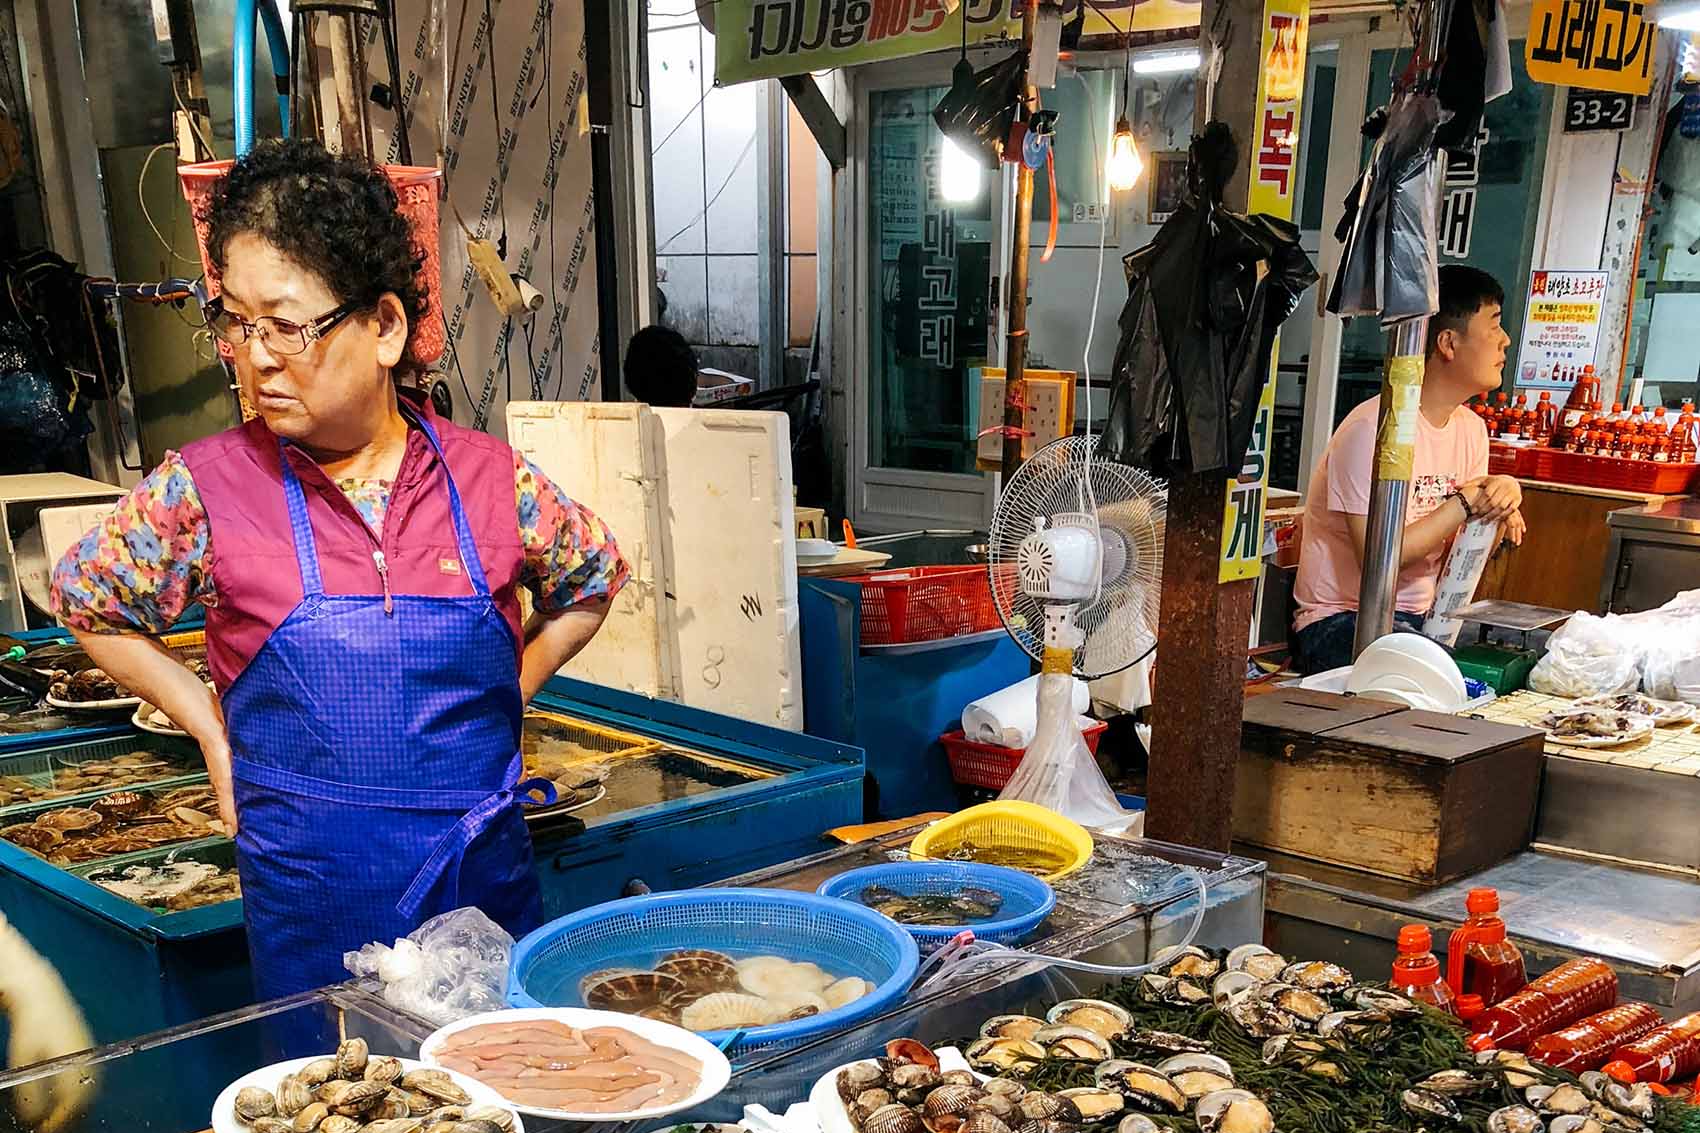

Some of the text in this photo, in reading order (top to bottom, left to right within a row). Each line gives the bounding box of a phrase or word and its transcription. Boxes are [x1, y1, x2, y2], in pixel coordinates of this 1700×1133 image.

[1531, 0, 1655, 79] 고래고기
[451, 12, 490, 136] STEEL STAINLESS
[509, 47, 533, 117] STAINLESS
[565, 71, 579, 108] STEEL
[1570, 99, 1627, 126] 33-2
[529, 198, 543, 233] STEEL
[562, 227, 584, 292] STAINLESS
